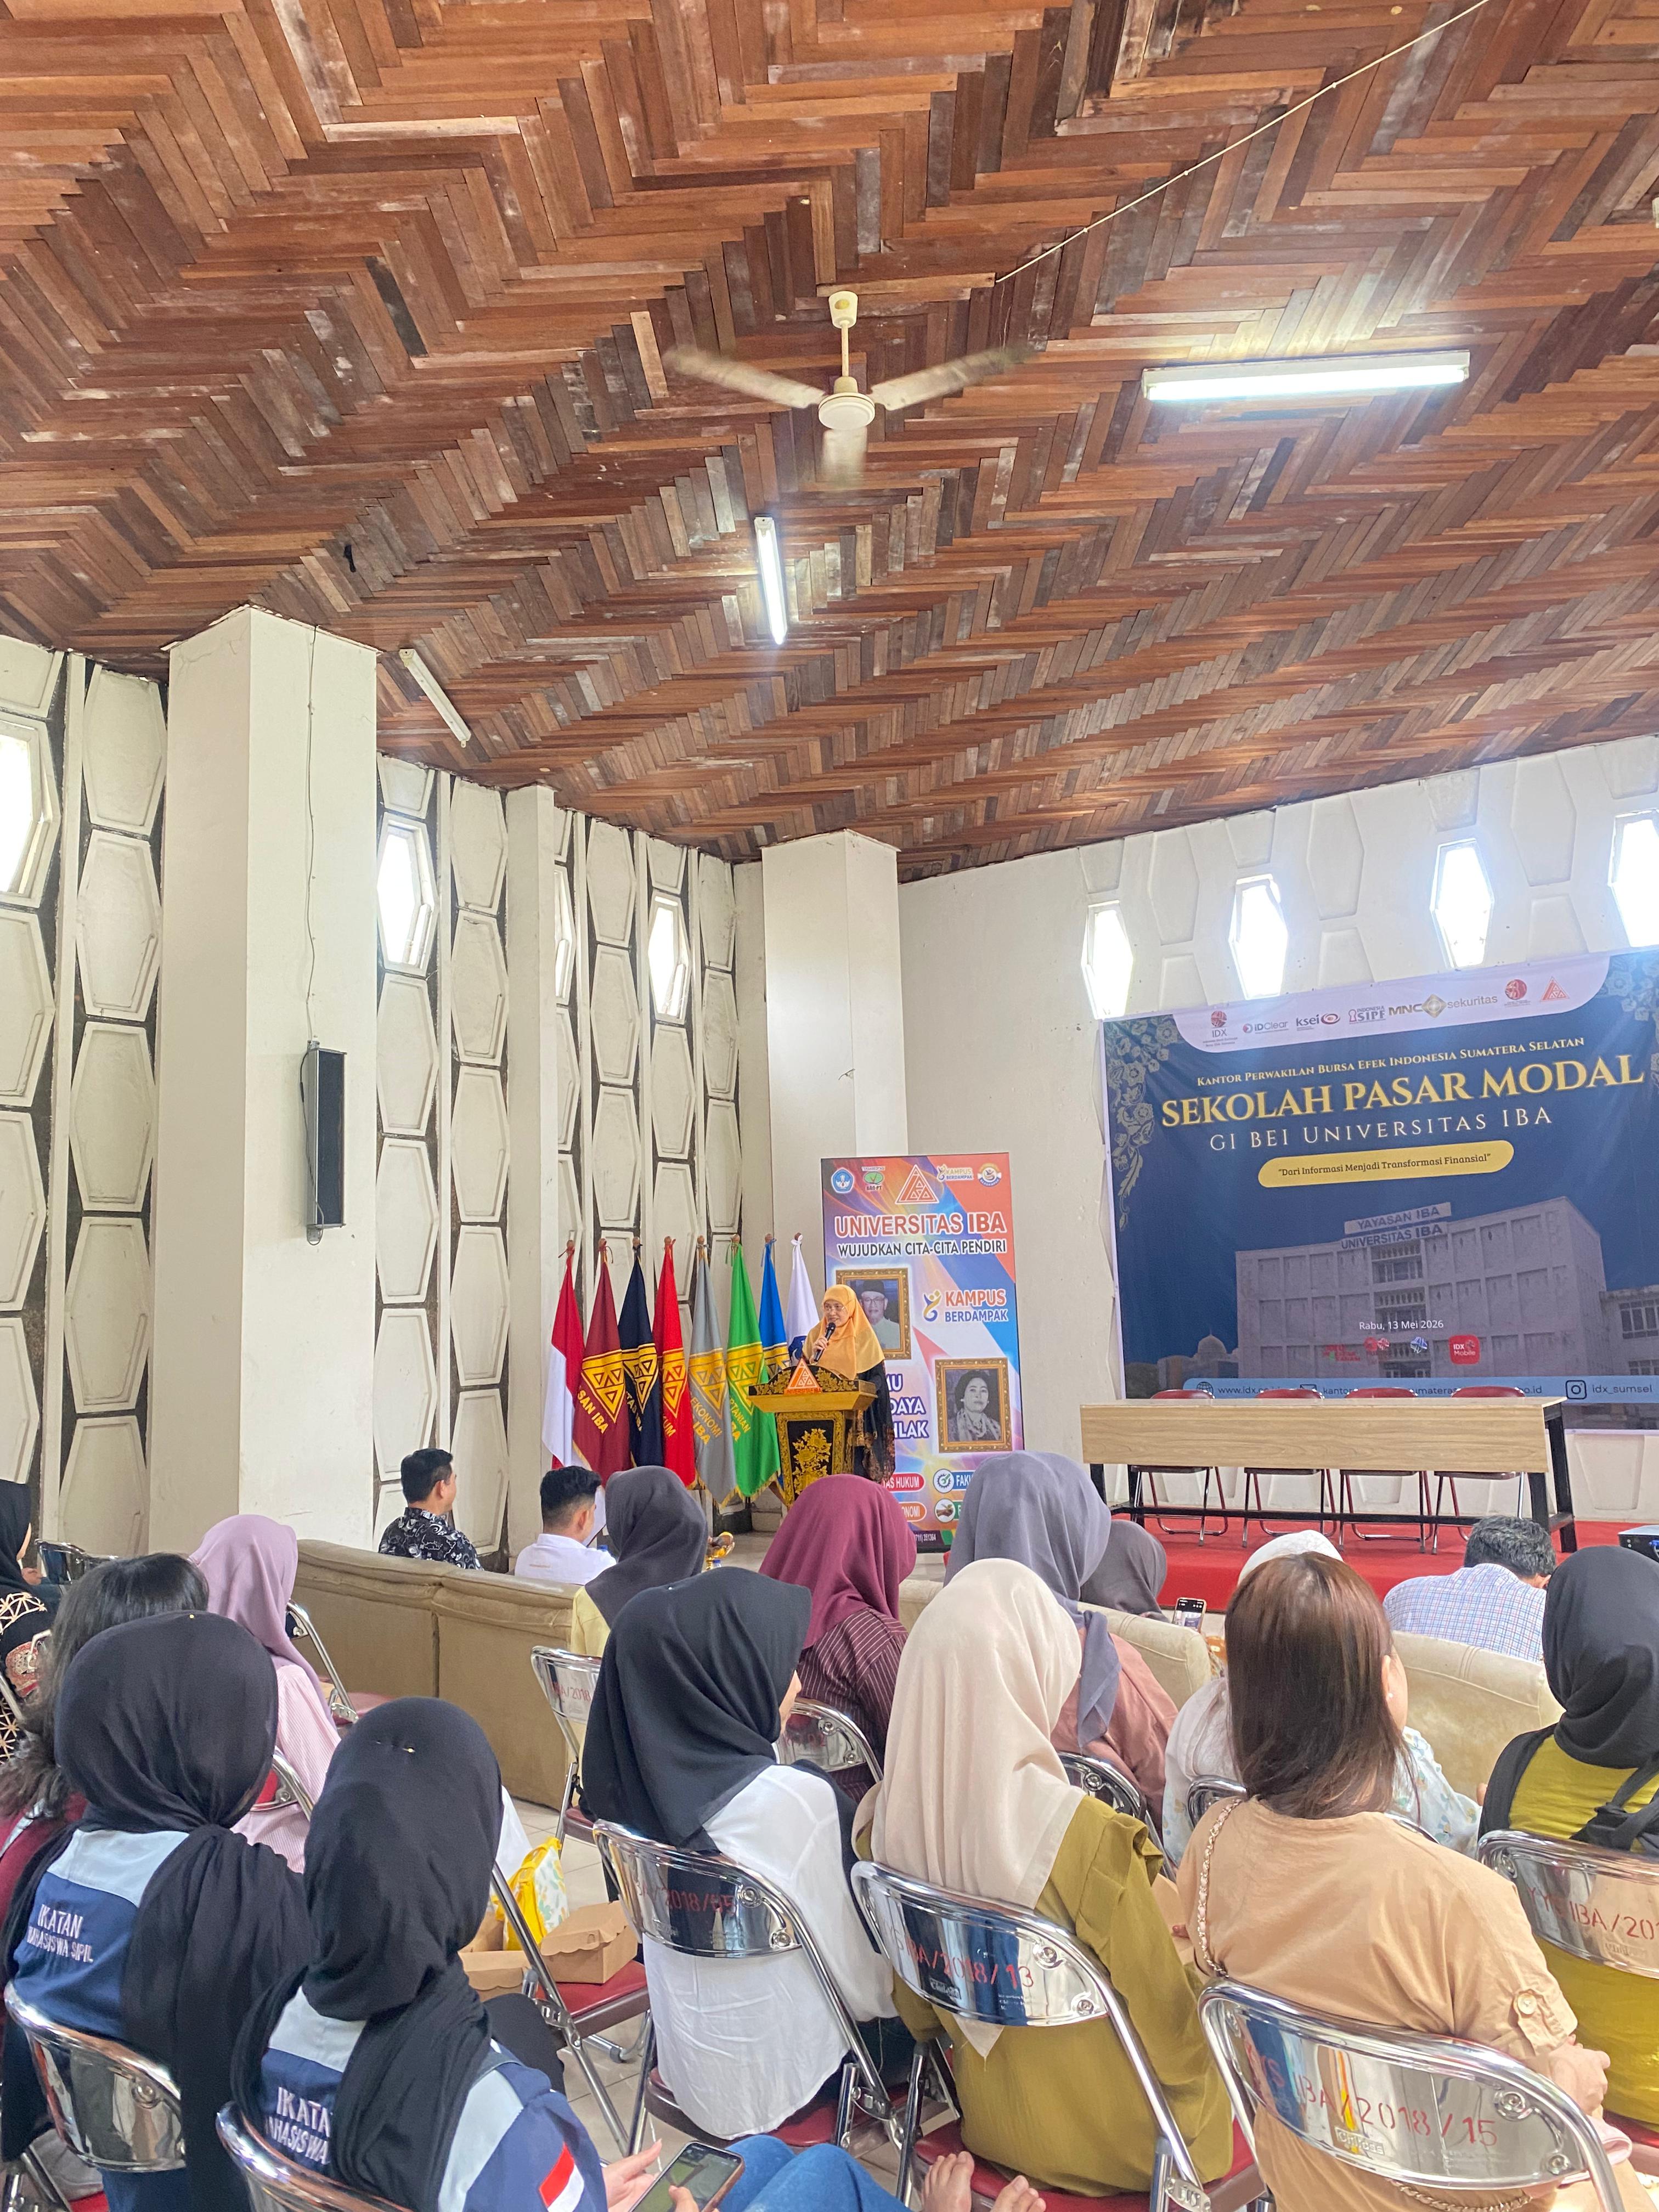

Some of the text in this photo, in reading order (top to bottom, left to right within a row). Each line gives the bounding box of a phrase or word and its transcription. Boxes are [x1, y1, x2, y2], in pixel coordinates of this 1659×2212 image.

[1389, 1003, 1422, 1015] MNC
[1447, 995, 1498, 1008] sekuritas
[1296, 1014, 1319, 1026] ksei
[1358, 1011, 1385, 1021] SIPF
[1212, 1029, 1228, 1037] IDX
[1162, 1054, 1645, 1127] SEKOLAH PASAR MODAL
[1210, 1107, 1552, 1151] GI BEI UNIVERSITAS IBA
[1302, 1164, 1344, 1175] Informasi
[1345, 1161, 1380, 1172] Menjadi
[1381, 1157, 1443, 1169] Transformasi
[836, 1212, 1006, 1237] UNIVERSITAS IBA
[1358, 1206, 1440, 1230] YAYASAN IBA
[1341, 1224, 1443, 1249] UNIVERSITAS IBA
[838, 1239, 1006, 1257] WUJUDKAN CITA-CITA PENDIRI
[945, 1289, 1006, 1307] KAMPUS
[945, 1309, 1008, 1322] BERDAMPAK
[1359, 1320, 1444, 1330] Rabu, 13 Mei 2026
[1592, 1384, 1652, 1395] idx_sumsel
[591, 1412, 608, 1434] IBA
[692, 1421, 710, 1445] IBA
[896, 1476, 919, 1488] HUKUM
[37, 1904, 83, 1939] IKATAN
[1570, 1900, 1659, 1940] IBA/20
[71, 1942, 94, 1963] SIPIL
[276, 2086, 331, 2137] IKATA
